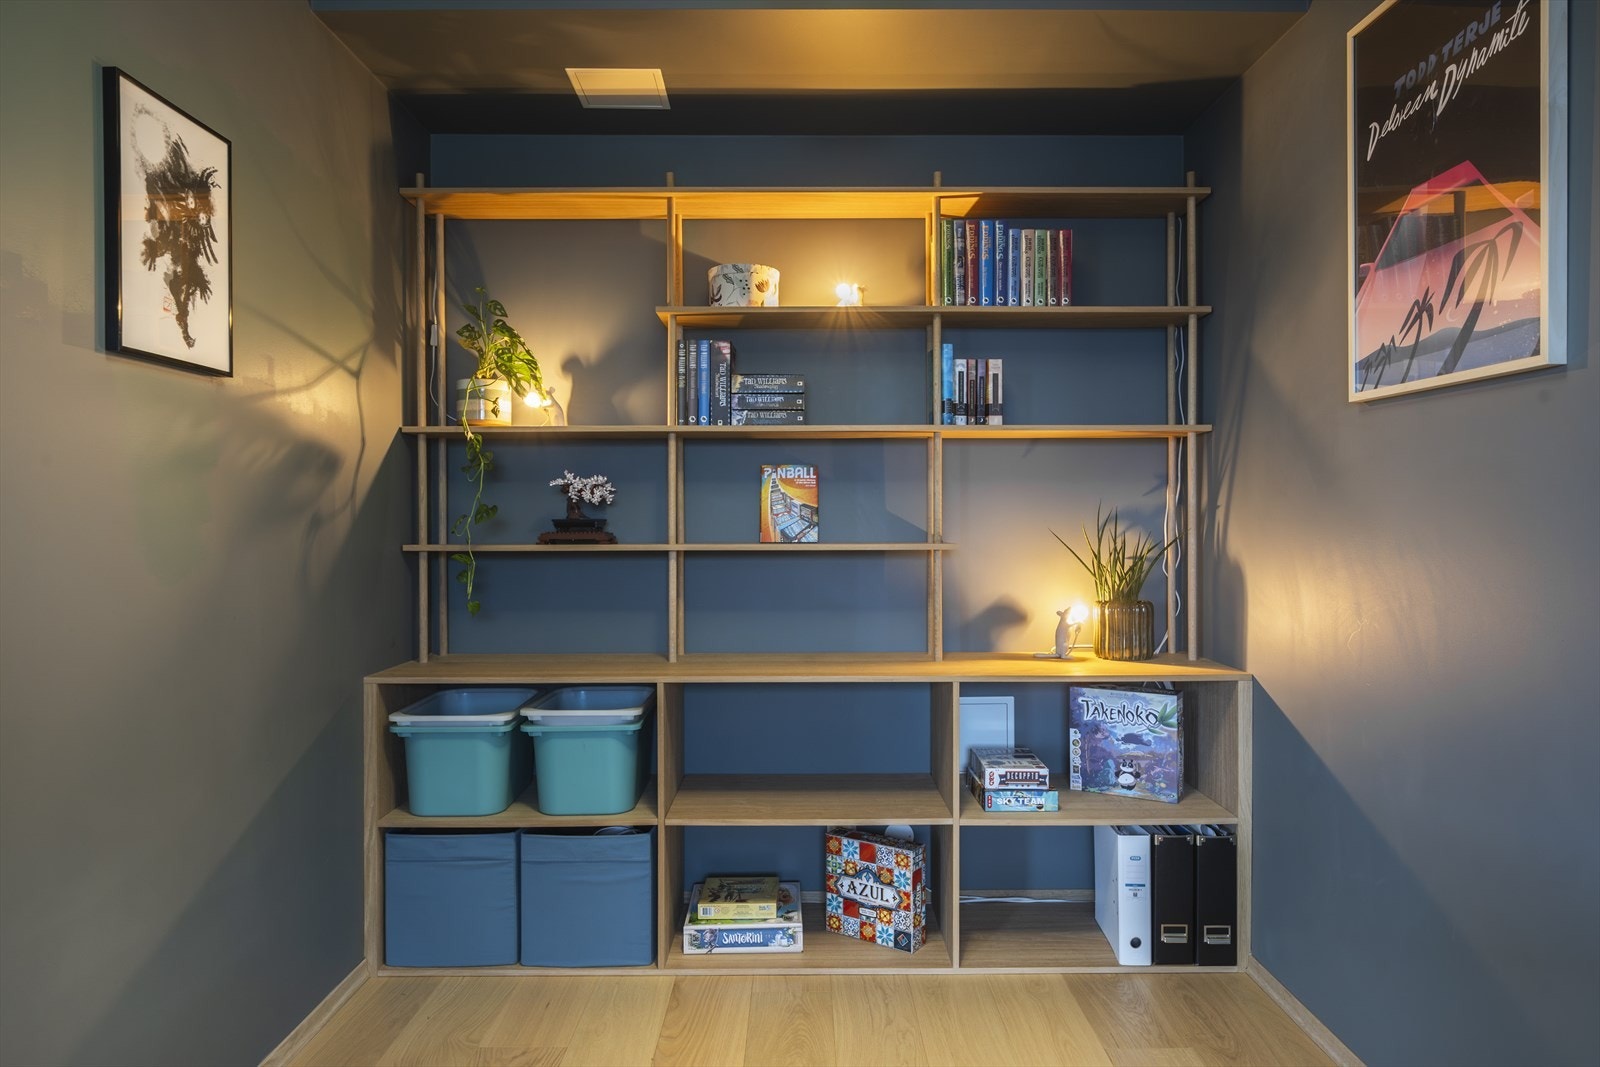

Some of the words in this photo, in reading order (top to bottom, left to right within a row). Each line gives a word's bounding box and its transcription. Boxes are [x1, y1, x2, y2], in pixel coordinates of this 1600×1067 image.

[1394, 53, 1438, 100] TODD
[1441, 2, 1502, 62] TERJE
[1436, 0, 1530, 116] Dynamite
[967, 224, 975, 259] EDDINGS
[981, 225, 989, 260] EDDINGS
[996, 224, 1004, 259] EDDINGS
[763, 467, 817, 479] PINBALL
[1080, 698, 1160, 727] TAKENOKO
[996, 797, 1016, 805] SKY
[1018, 797, 1046, 805] TEAM
[846, 881, 889, 903] AZUL
